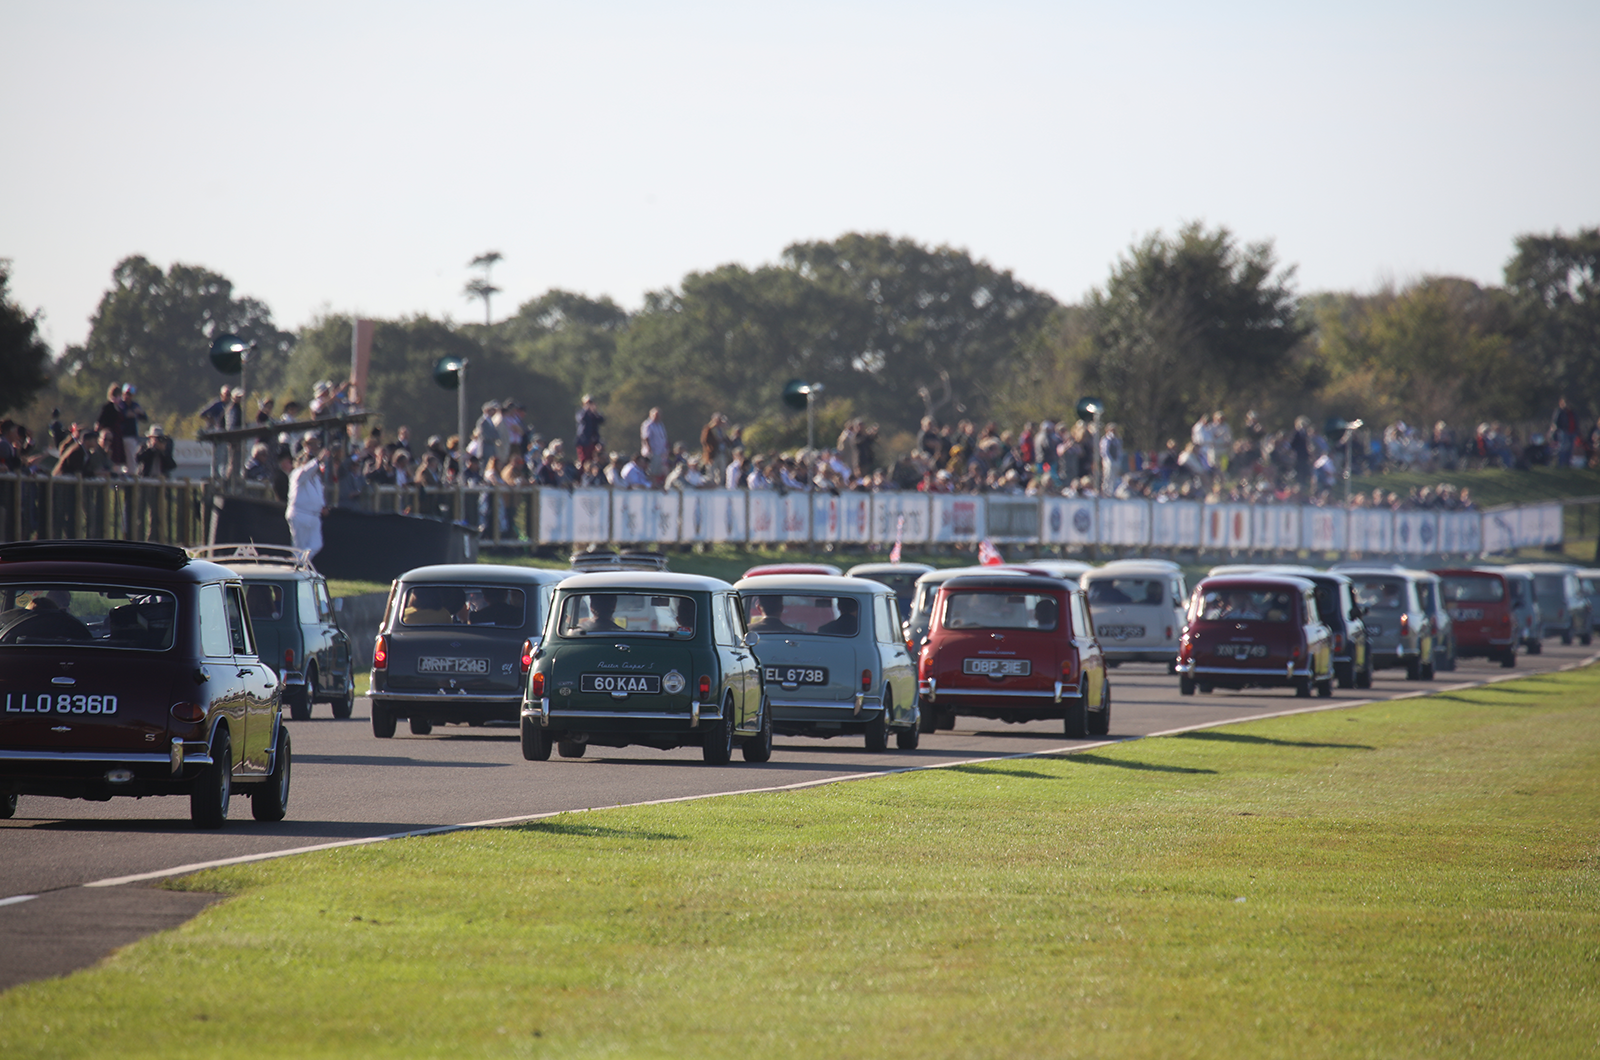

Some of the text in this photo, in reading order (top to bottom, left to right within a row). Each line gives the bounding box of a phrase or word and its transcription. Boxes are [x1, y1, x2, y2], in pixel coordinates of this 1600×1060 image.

[972, 661, 999, 673] OBP
[786, 668, 824, 683] 673B
[594, 677, 648, 691] 60 KAA
[6, 693, 118, 715] LLO 836D
[145, 733, 155, 742] S
